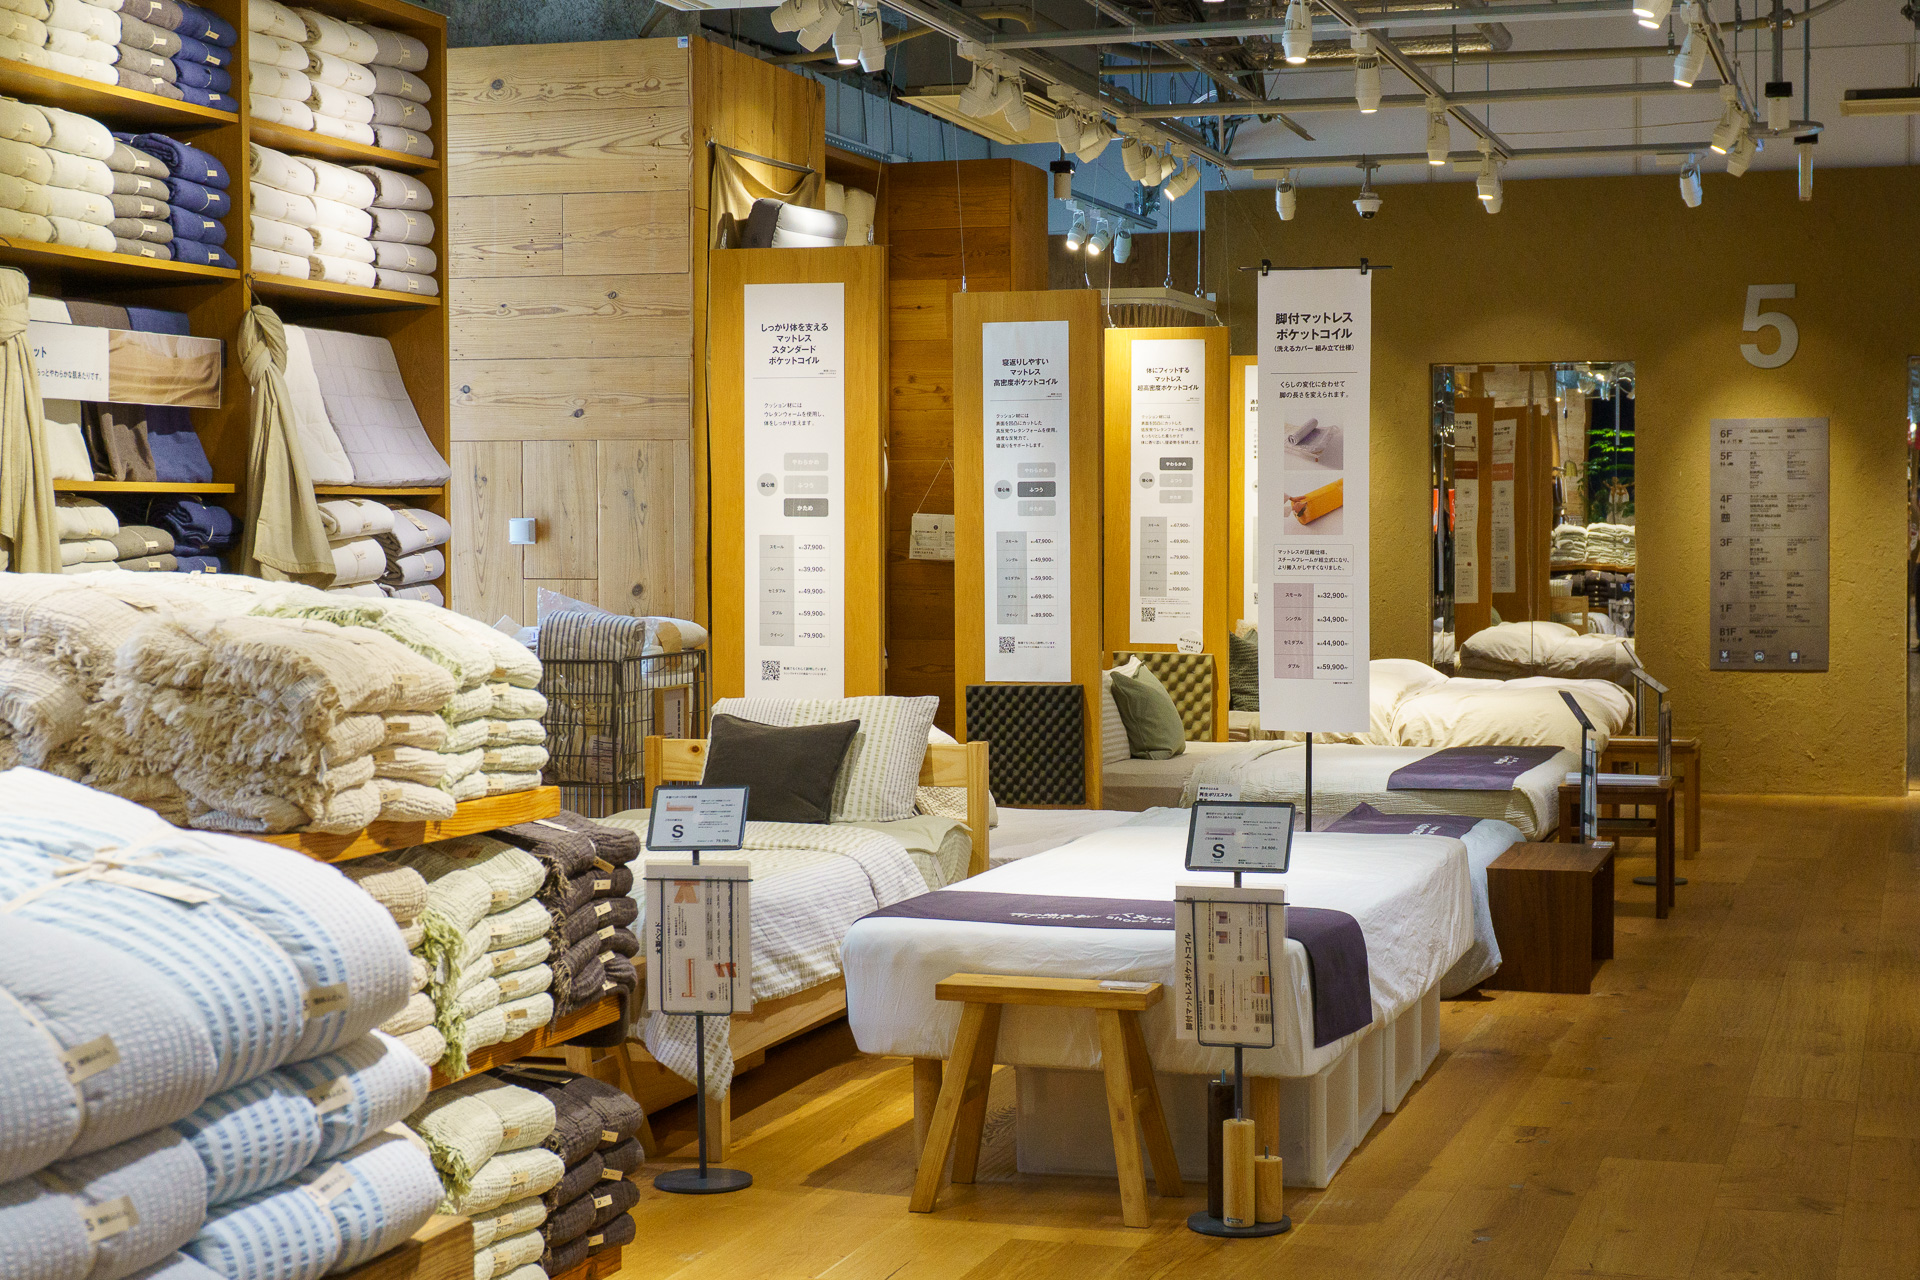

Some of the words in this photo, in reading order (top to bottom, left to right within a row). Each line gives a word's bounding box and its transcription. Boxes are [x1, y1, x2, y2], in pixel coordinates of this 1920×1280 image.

[1275, 312, 1353, 325] 脚付マットレス
[761, 322, 829, 332] しっかり体を支える
[1740, 284, 1798, 368] 5
[776, 334, 812, 343] マットレス
[1276, 328, 1353, 340] ポケットコイル
[772, 345, 817, 354] スタンダード
[768, 356, 820, 366] ポケットコイル
[1002, 358, 1049, 367] 寝返りしやすい
[1009, 368, 1041, 376] マットレス
[993, 379, 1058, 387] 高密度ポケットコイル
[1280, 381, 1346, 389] くらしの変化に合わせて
[1279, 391, 1349, 399] 脚の長さを変えられます。
[1720, 429, 1733, 438] 6F
[1720, 452, 1733, 460] 5F
[1720, 495, 1733, 503] 4F
[1720, 538, 1732, 546] 3F
[1720, 572, 1732, 580] 2F
[1720, 604, 1732, 612] 1F
[1720, 628, 1736, 636] B1F
[672, 825, 684, 838] S
[1212, 844, 1225, 858] S
[1185, 932, 1193, 1031] 脚付マットレスポケットコイル
[64, 1061, 75, 1074] S
[85, 1218, 95, 1231] S
